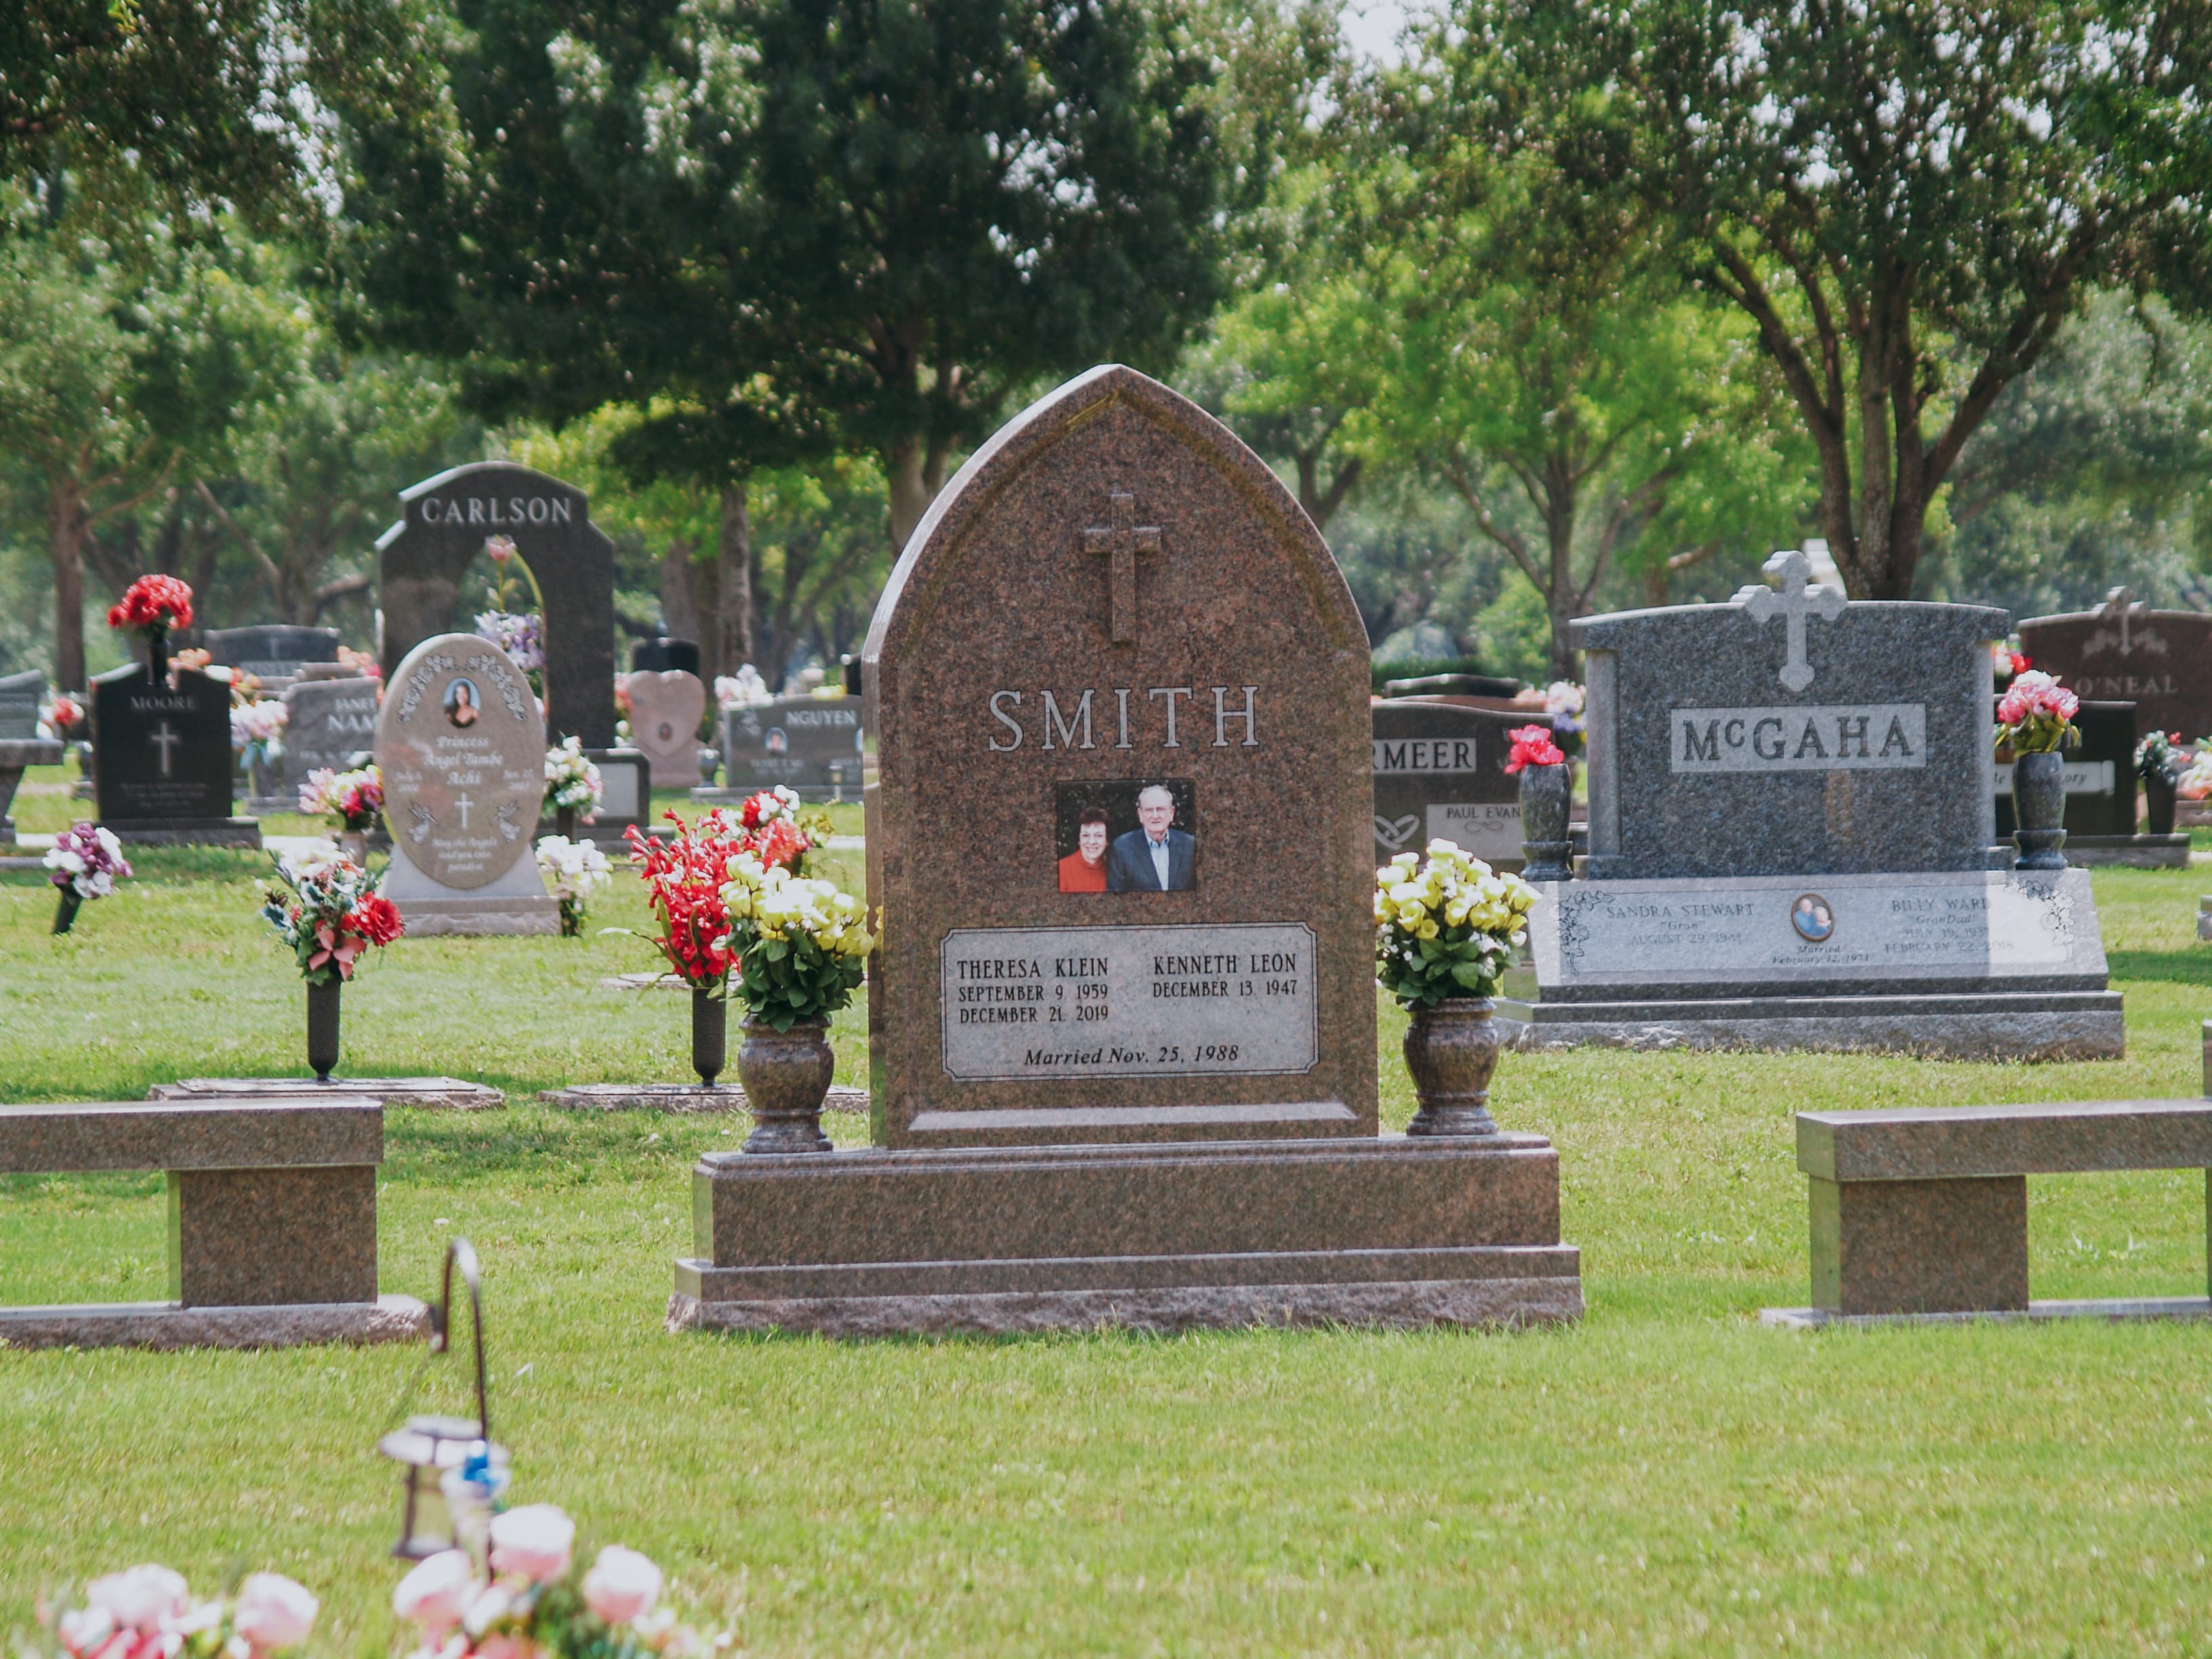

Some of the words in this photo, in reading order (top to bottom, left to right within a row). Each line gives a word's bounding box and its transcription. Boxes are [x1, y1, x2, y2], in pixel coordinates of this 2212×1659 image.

[422, 497, 571, 523] CARLSON
[2075, 676, 2178, 694] O'NEAL
[130, 695, 197, 710] MOORE
[785, 710, 857, 725] NGUYEN
[989, 685, 1260, 752] SMITH
[1446, 807, 1478, 819] PAUL
[1606, 905, 1672, 919] SANDRA
[1681, 903, 1755, 916] STEWART
[1891, 899, 1935, 912] BILLY
[1946, 897, 1992, 910] WARD
[1630, 933, 1682, 945] AUGUST
[1885, 941, 1950, 954] FEBRUARY
[1798, 945, 1841, 954] Married
[1154, 955, 1237, 975] KENNETH
[1251, 953, 1296, 973] LEON
[1772, 954, 1822, 965] February
[957, 960, 1042, 979] THERESA
[1056, 958, 1109, 977] KLEIN
[959, 985, 1044, 1002] SEPTEMBER
[1077, 983, 1109, 1000] 1959
[1153, 981, 1229, 998] DECEMBER
[1267, 979, 1298, 995] 1947
[960, 1006, 1038, 1024] DECEMBER
[1076, 1005, 1109, 1021] 2019
[1024, 1048, 1103, 1066] Married
[1108, 1048, 1149, 1065] Nov.
[1157, 1046, 1185, 1063] 25,
[1195, 1045, 1240, 1062] 1988
